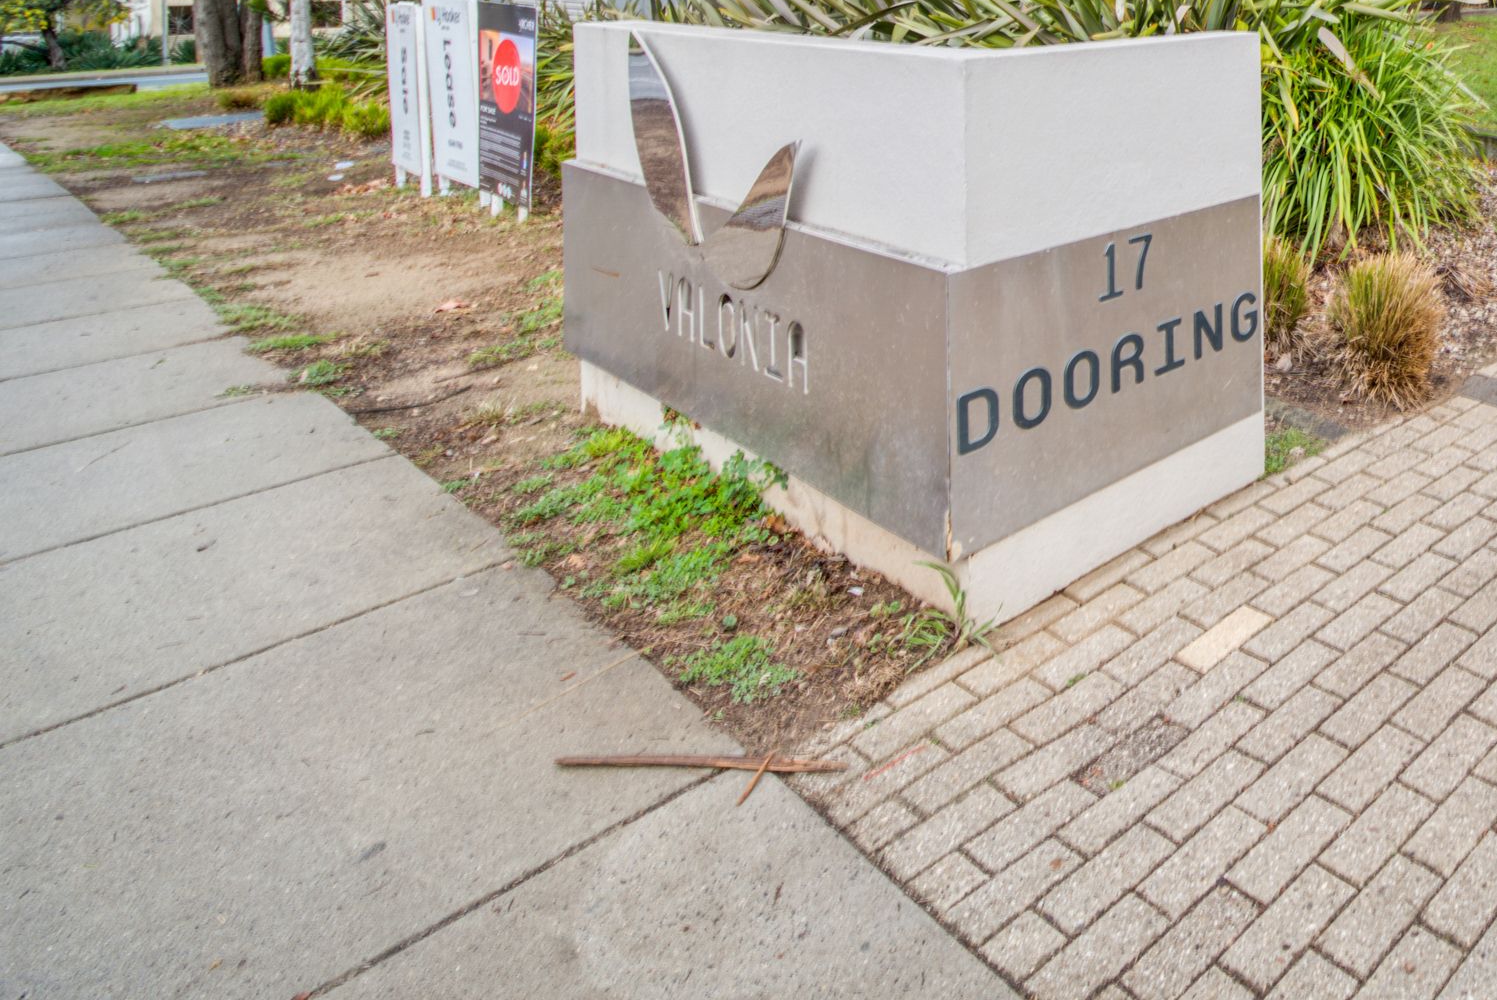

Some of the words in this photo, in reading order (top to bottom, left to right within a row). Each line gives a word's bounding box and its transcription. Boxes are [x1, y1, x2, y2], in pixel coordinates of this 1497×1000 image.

[443, 39, 456, 128] Lease
[495, 65, 519, 87] SOLD
[1098, 233, 1153, 303] 17
[657, 269, 809, 396] VALONIA
[956, 291, 1259, 456] DOORING
